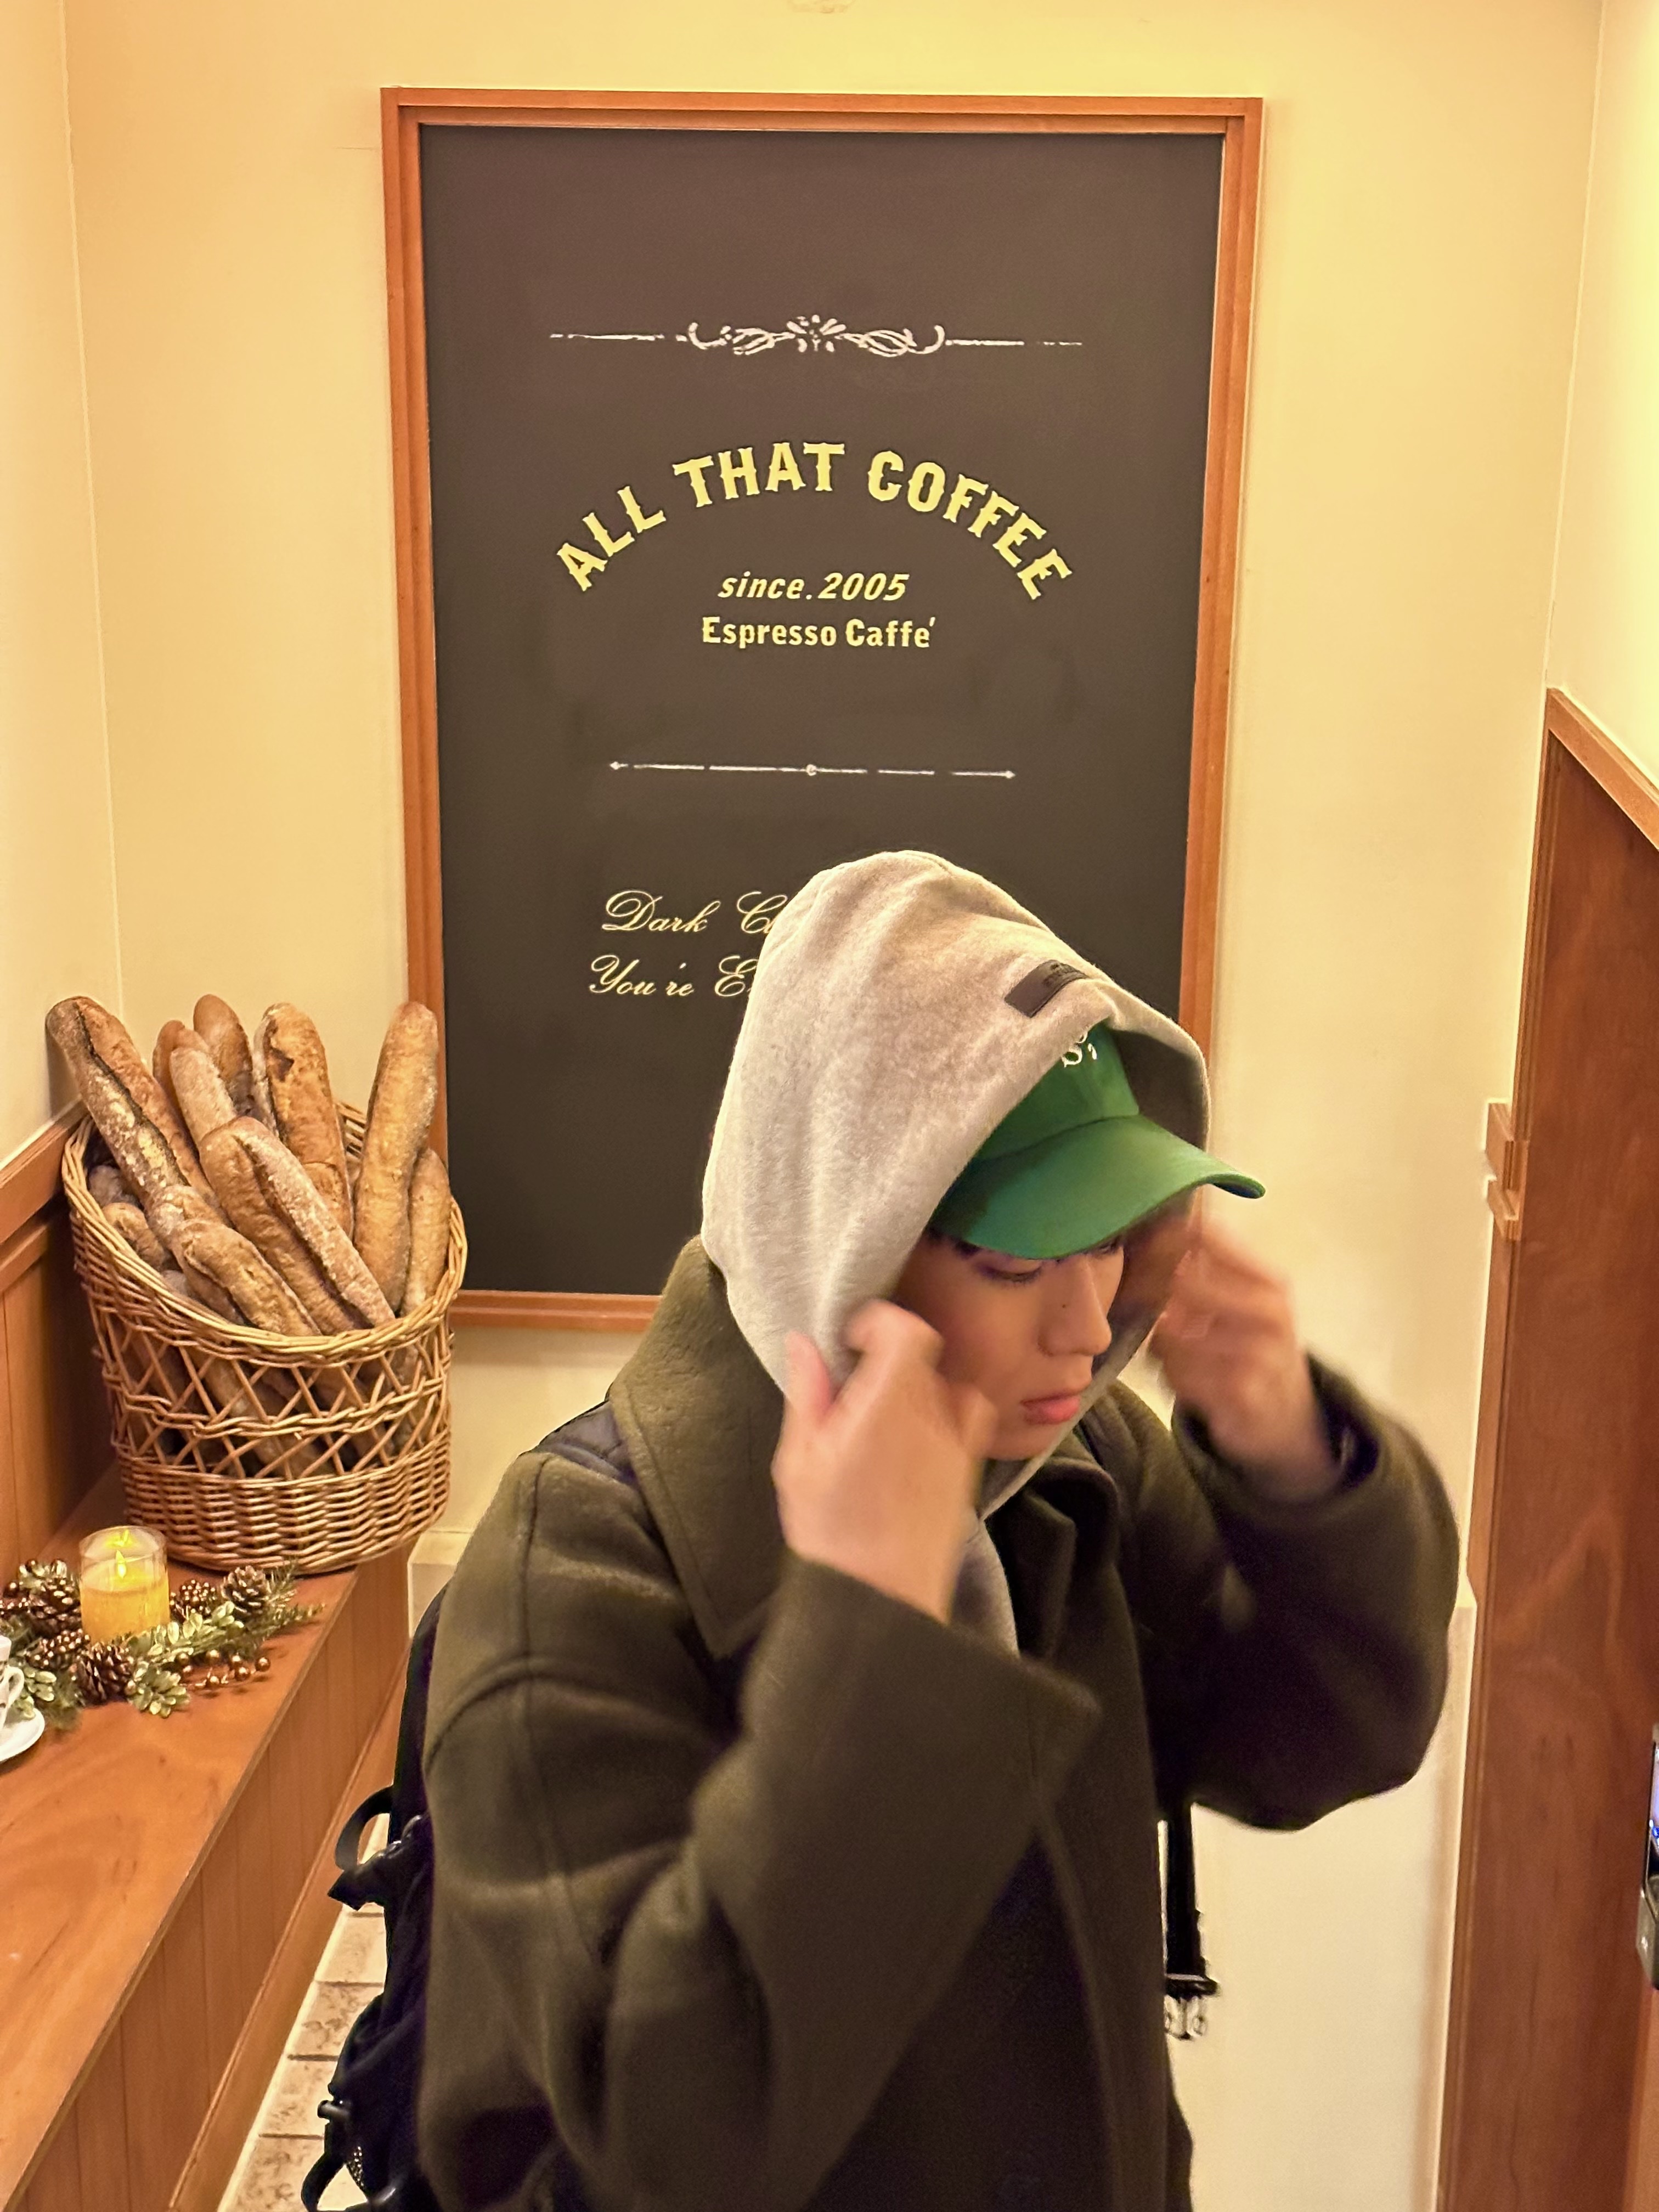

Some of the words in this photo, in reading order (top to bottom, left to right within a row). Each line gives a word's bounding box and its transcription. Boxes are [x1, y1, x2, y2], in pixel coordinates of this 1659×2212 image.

[556, 486, 667, 592] ALL
[672, 442, 845, 507] THAT
[867, 450, 1073, 600] COFFEE
[702, 616, 837, 649] Espresso
[601, 890, 721, 933] Dark
